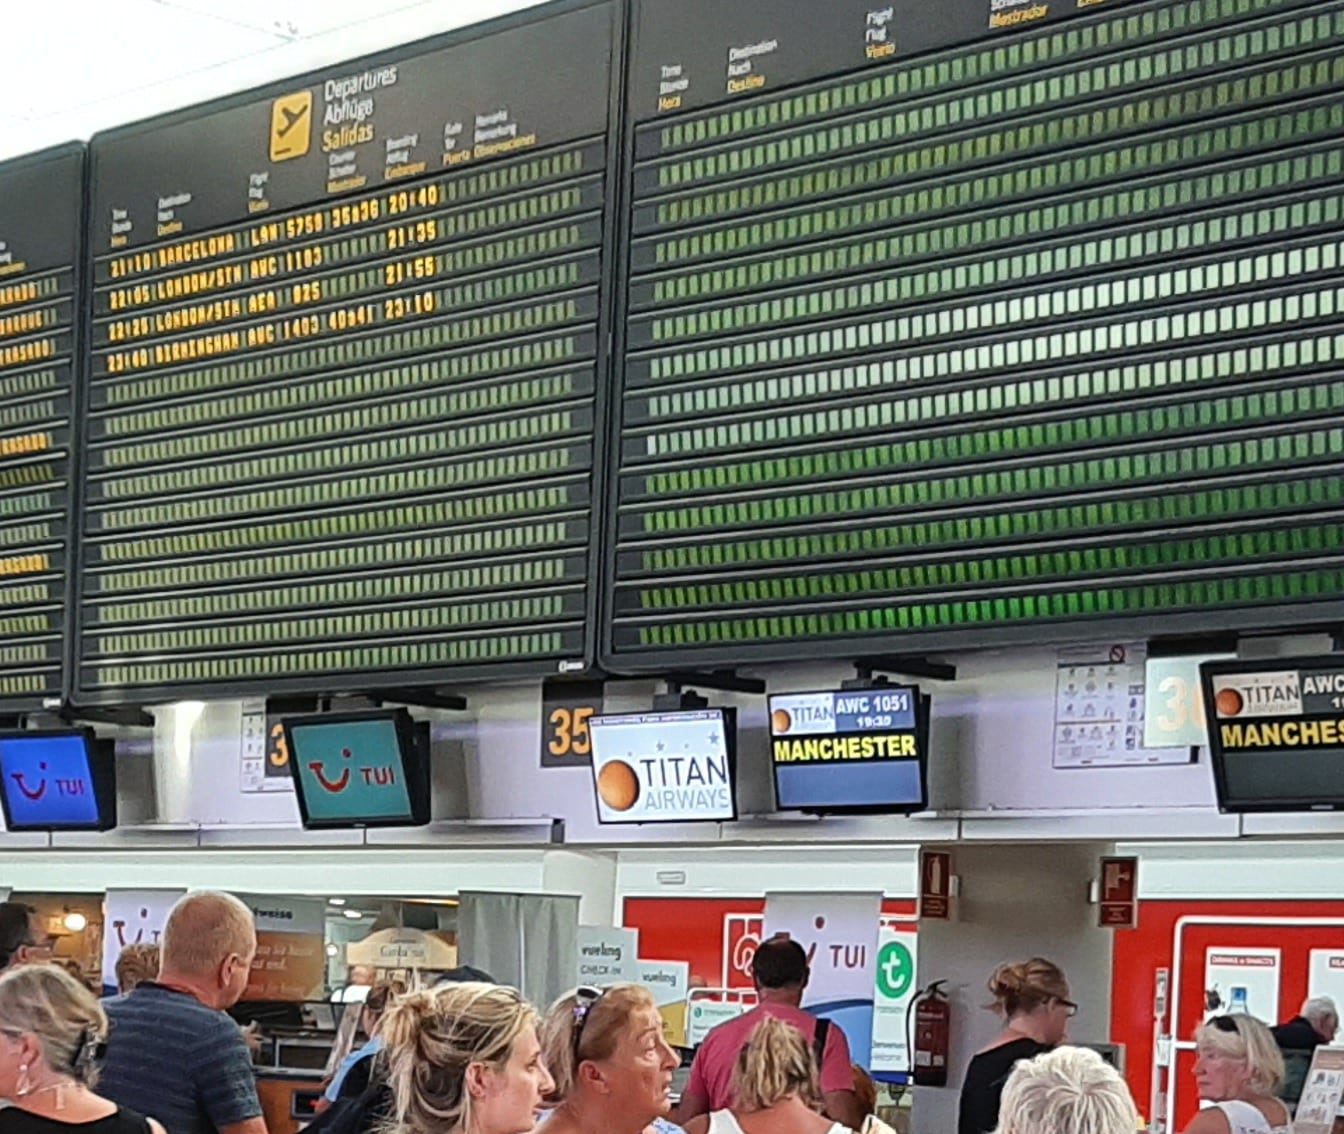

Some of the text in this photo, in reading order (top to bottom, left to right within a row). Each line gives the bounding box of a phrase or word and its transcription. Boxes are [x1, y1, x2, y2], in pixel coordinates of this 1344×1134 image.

[325, 67, 397, 101] Departures
[324, 96, 373, 126] Abflüge
[322, 122, 373, 152] Salidas
[159, 233, 234, 267] BARCELONA
[389, 184, 438, 214] 20:40
[110, 284, 150, 310] 22:05
[287, 247, 322, 272] 1103
[388, 220, 436, 249] 21:35
[386, 256, 435, 285] 21:55
[156, 331, 239, 364] BIRMINGHAM
[385, 291, 433, 319] 23:10
[836, 694, 908, 714] AWC 1051
[1242, 685, 1299, 704] TITAN
[792, 704, 833, 723] TITAN
[548, 706, 593, 756] 35
[774, 734, 917, 762] MANCHESTER
[359, 767, 395, 785] TUI
[640, 755, 727, 787] TITAN
[56, 778, 85, 796] TUI
[645, 788, 729, 810] AIRWAYS
[582, 942, 621, 960] vueling
[829, 945, 865, 968] TUI
